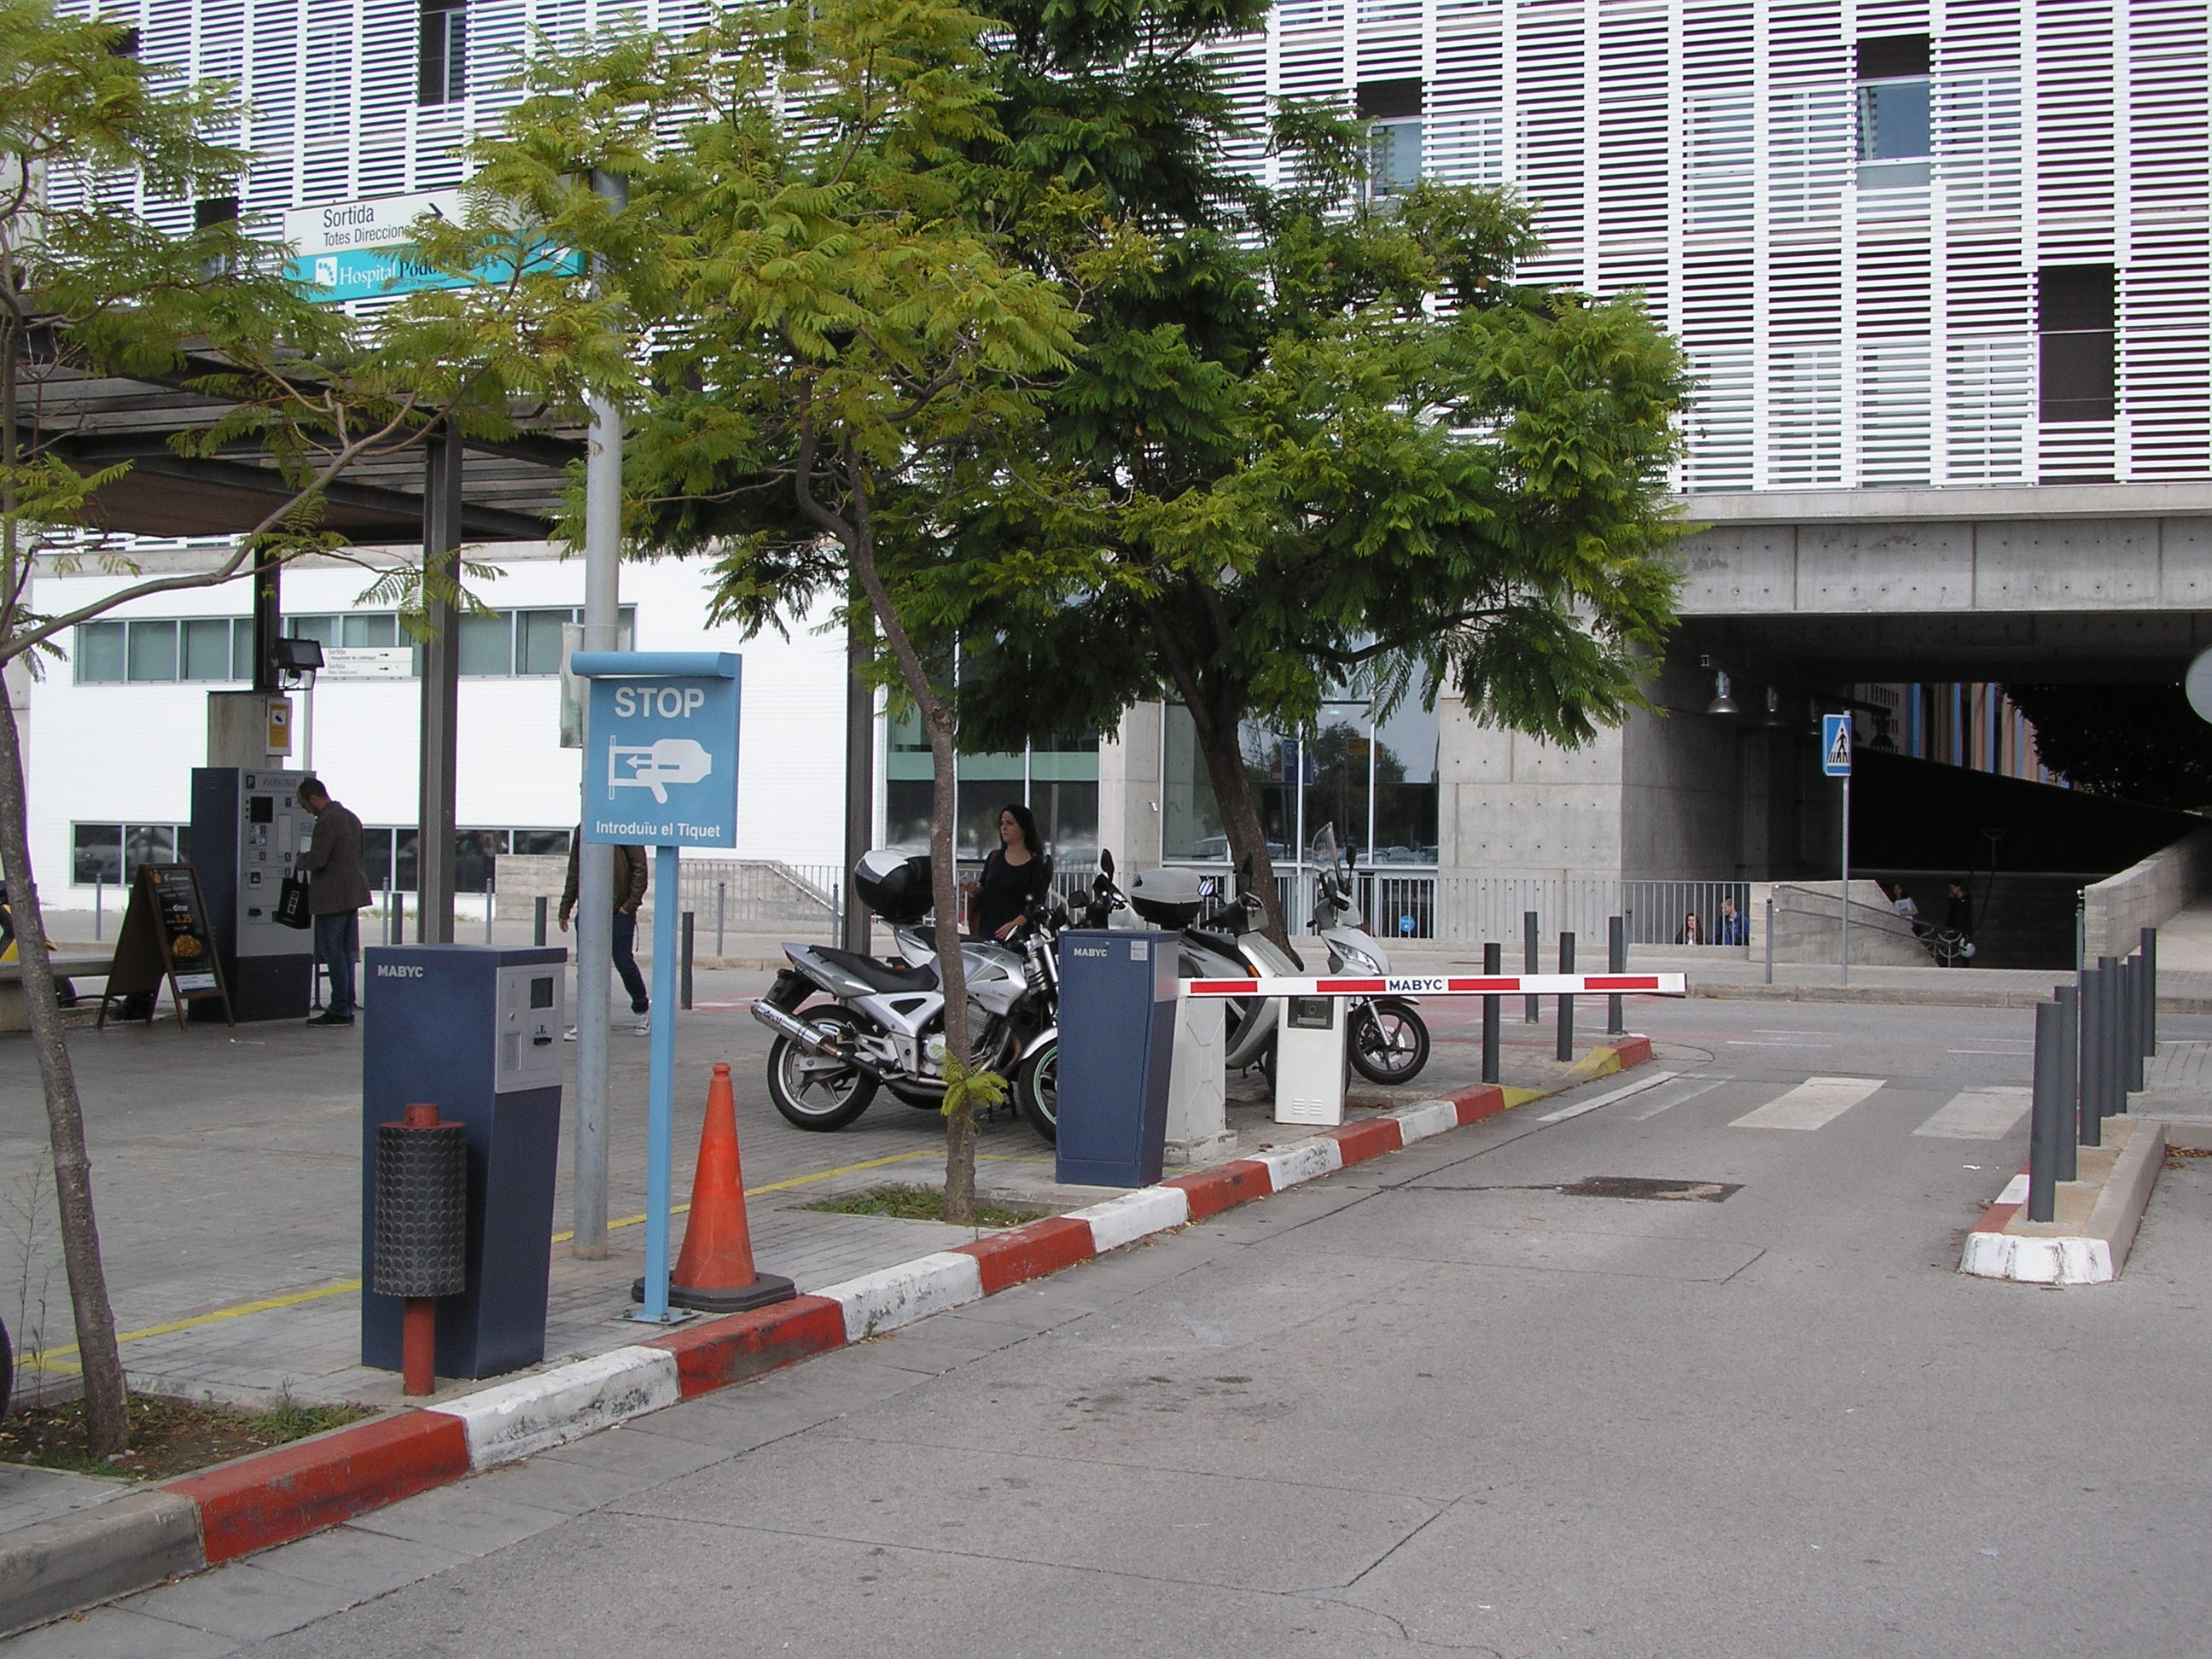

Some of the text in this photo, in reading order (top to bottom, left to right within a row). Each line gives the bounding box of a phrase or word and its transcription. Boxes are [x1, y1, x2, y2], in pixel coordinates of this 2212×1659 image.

[323, 205, 375, 229] Sortida
[323, 231, 351, 247] Totes
[340, 263, 397, 288] Hospital
[614, 686, 705, 719] STOP
[262, 777, 297, 788] PARKING
[596, 820, 721, 839] Introduïu el Tiquet
[1074, 947, 1108, 958] MABYC
[377, 964, 424, 978] MABYC
[1388, 979, 1443, 991] MABYC
